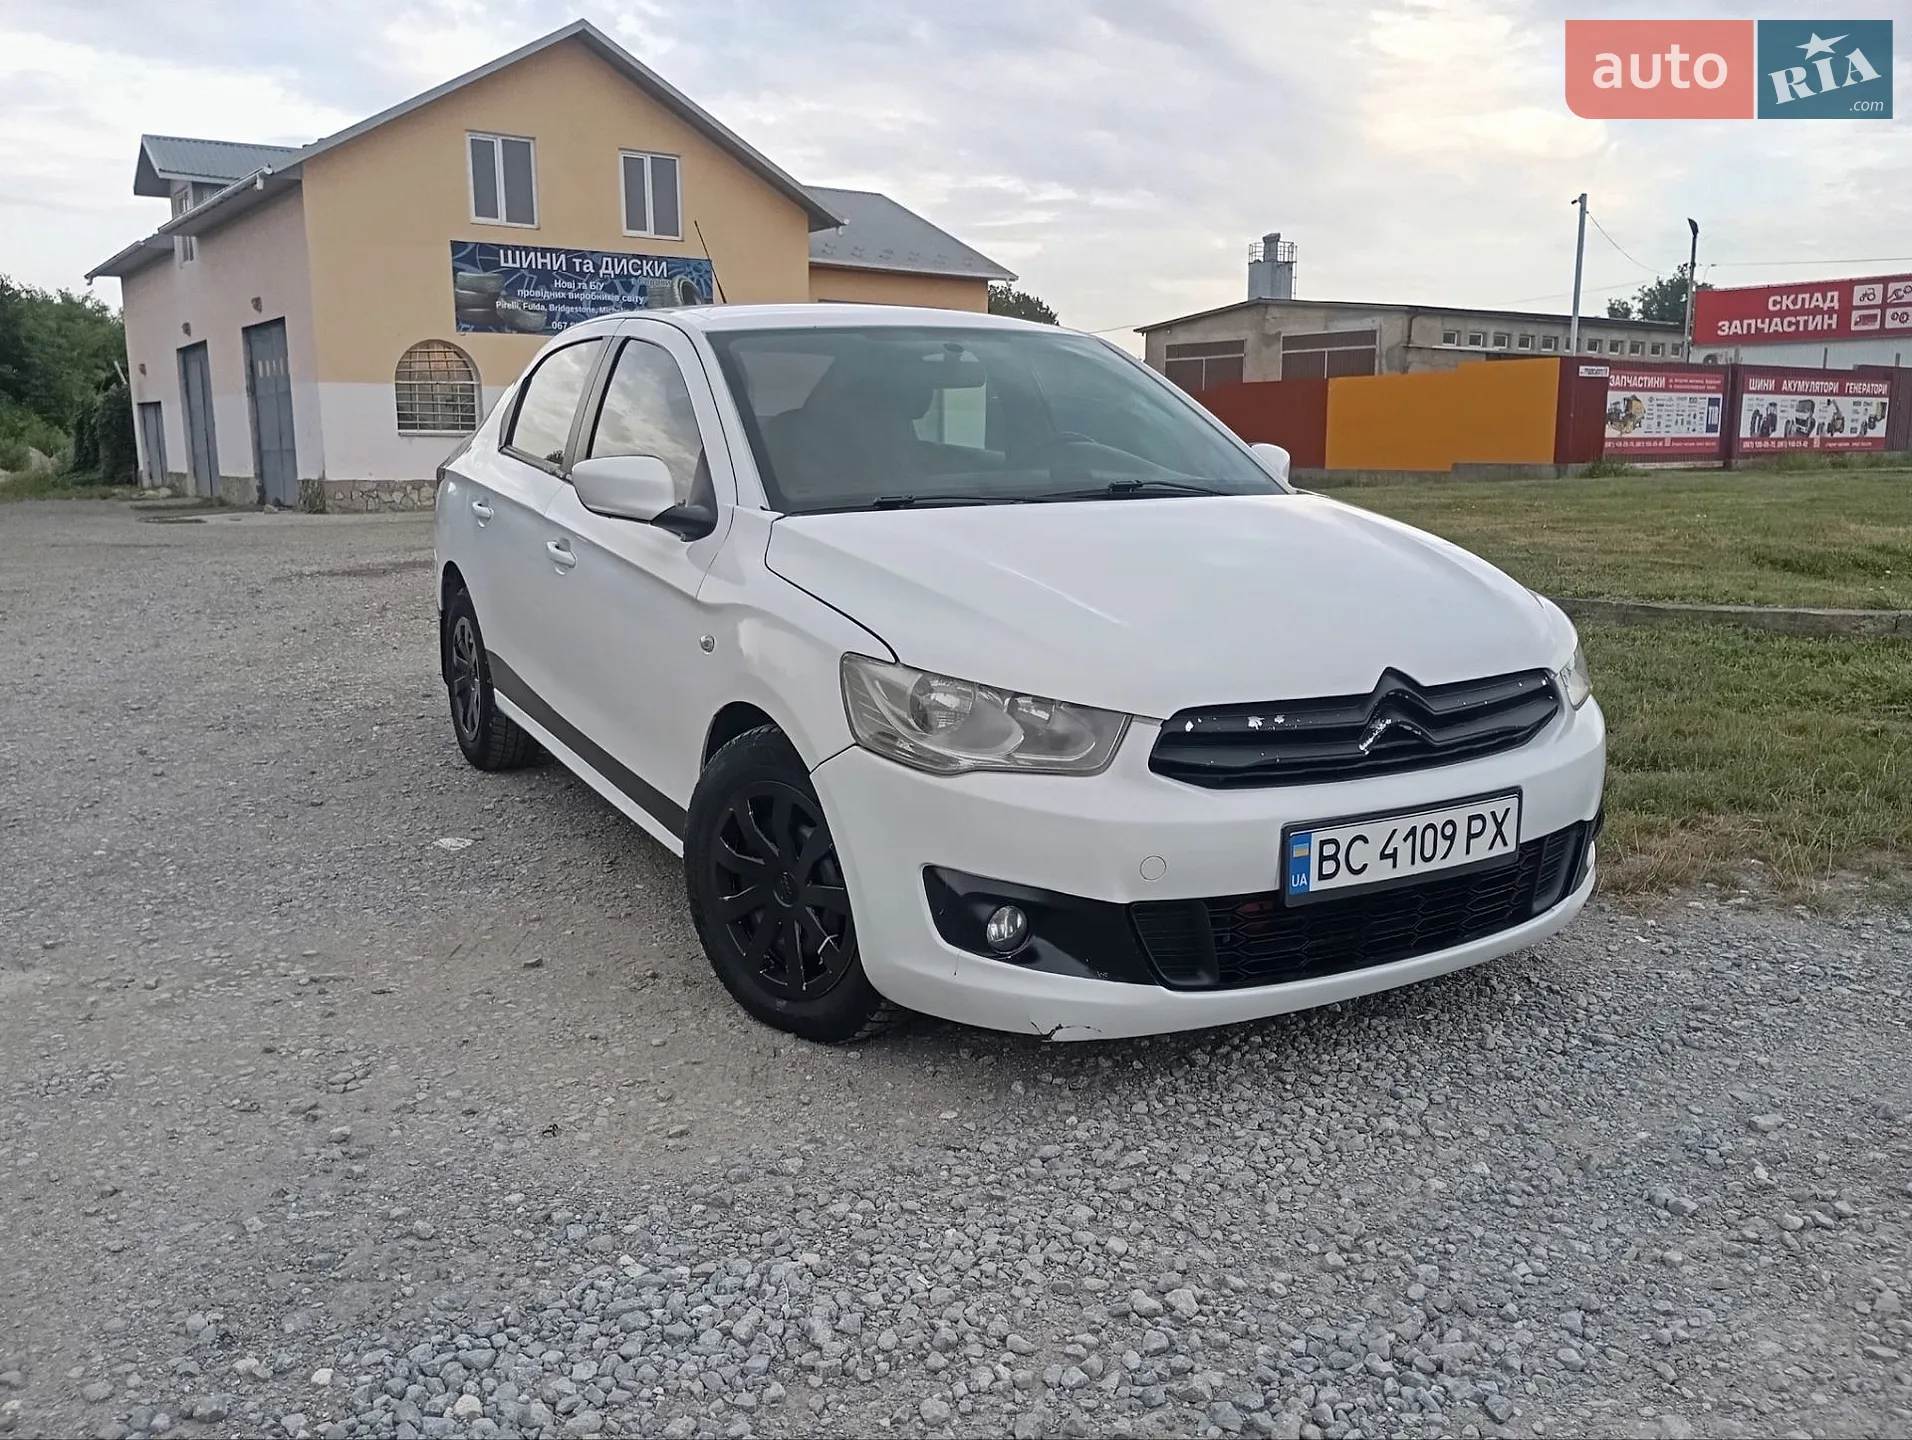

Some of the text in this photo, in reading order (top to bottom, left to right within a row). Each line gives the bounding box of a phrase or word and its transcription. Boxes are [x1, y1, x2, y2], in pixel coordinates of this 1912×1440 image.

[499, 249, 668, 279] ШИНИ та ДИСКИ
[554, 279, 575, 289] Нові
[578, 282, 588, 290] та
[517, 288, 566, 299] провідних
[568, 291, 620, 302] виробників
[1768, 291, 1839, 312] СКЛАД
[523, 302, 547, 312] Fulda,
[549, 303, 598, 314] Bridgestone,
[551, 321, 567, 330] 067
[1717, 314, 1837, 336] ЗАПЧАСТИН
[1609, 375, 1666, 389] ЗАПЧАСТИНИ
[1748, 378, 1888, 395] ШИНИ АКУМУЛЯТОРИ ГЕНЕРАТОРИ
[1317, 807, 1511, 881] BC 4109 PX
[1291, 874, 1308, 887] UA
